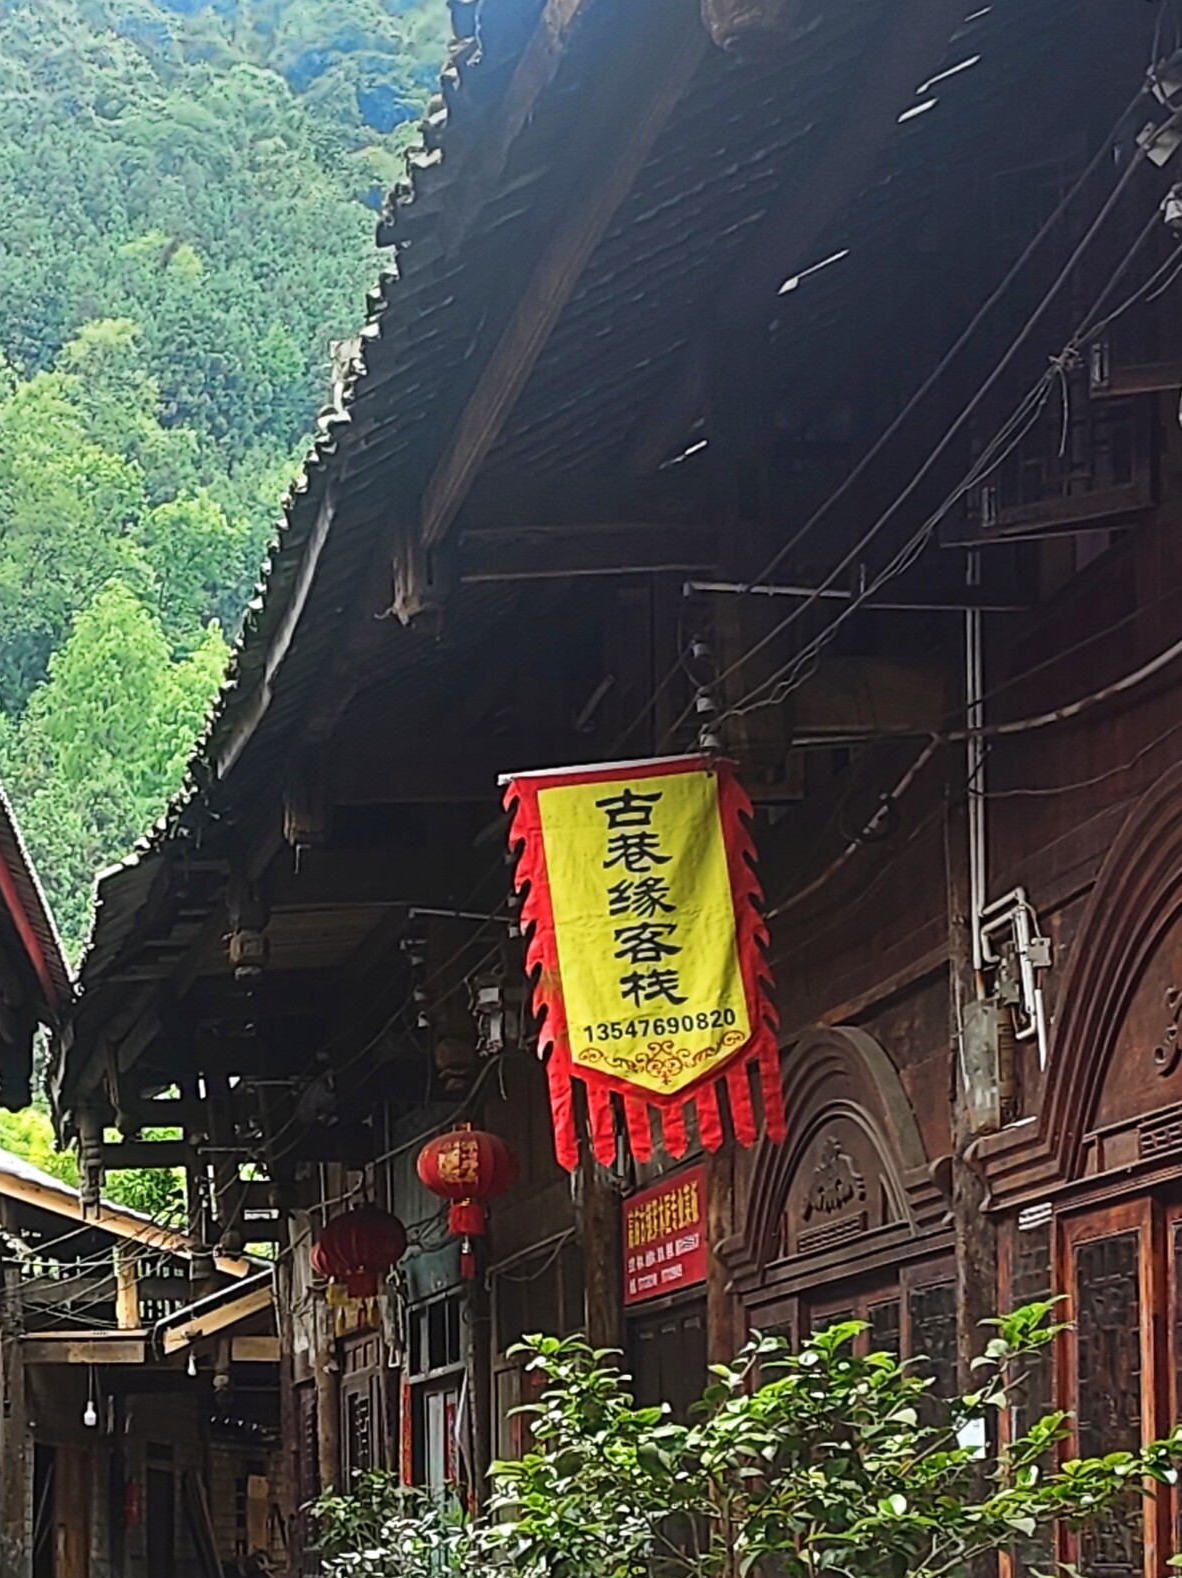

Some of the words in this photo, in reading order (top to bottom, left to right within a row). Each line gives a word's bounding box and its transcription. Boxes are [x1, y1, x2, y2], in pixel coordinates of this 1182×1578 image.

[595, 788, 688, 1007] 古巷缘客栈
[584, 1008, 736, 1043] 13547690820
